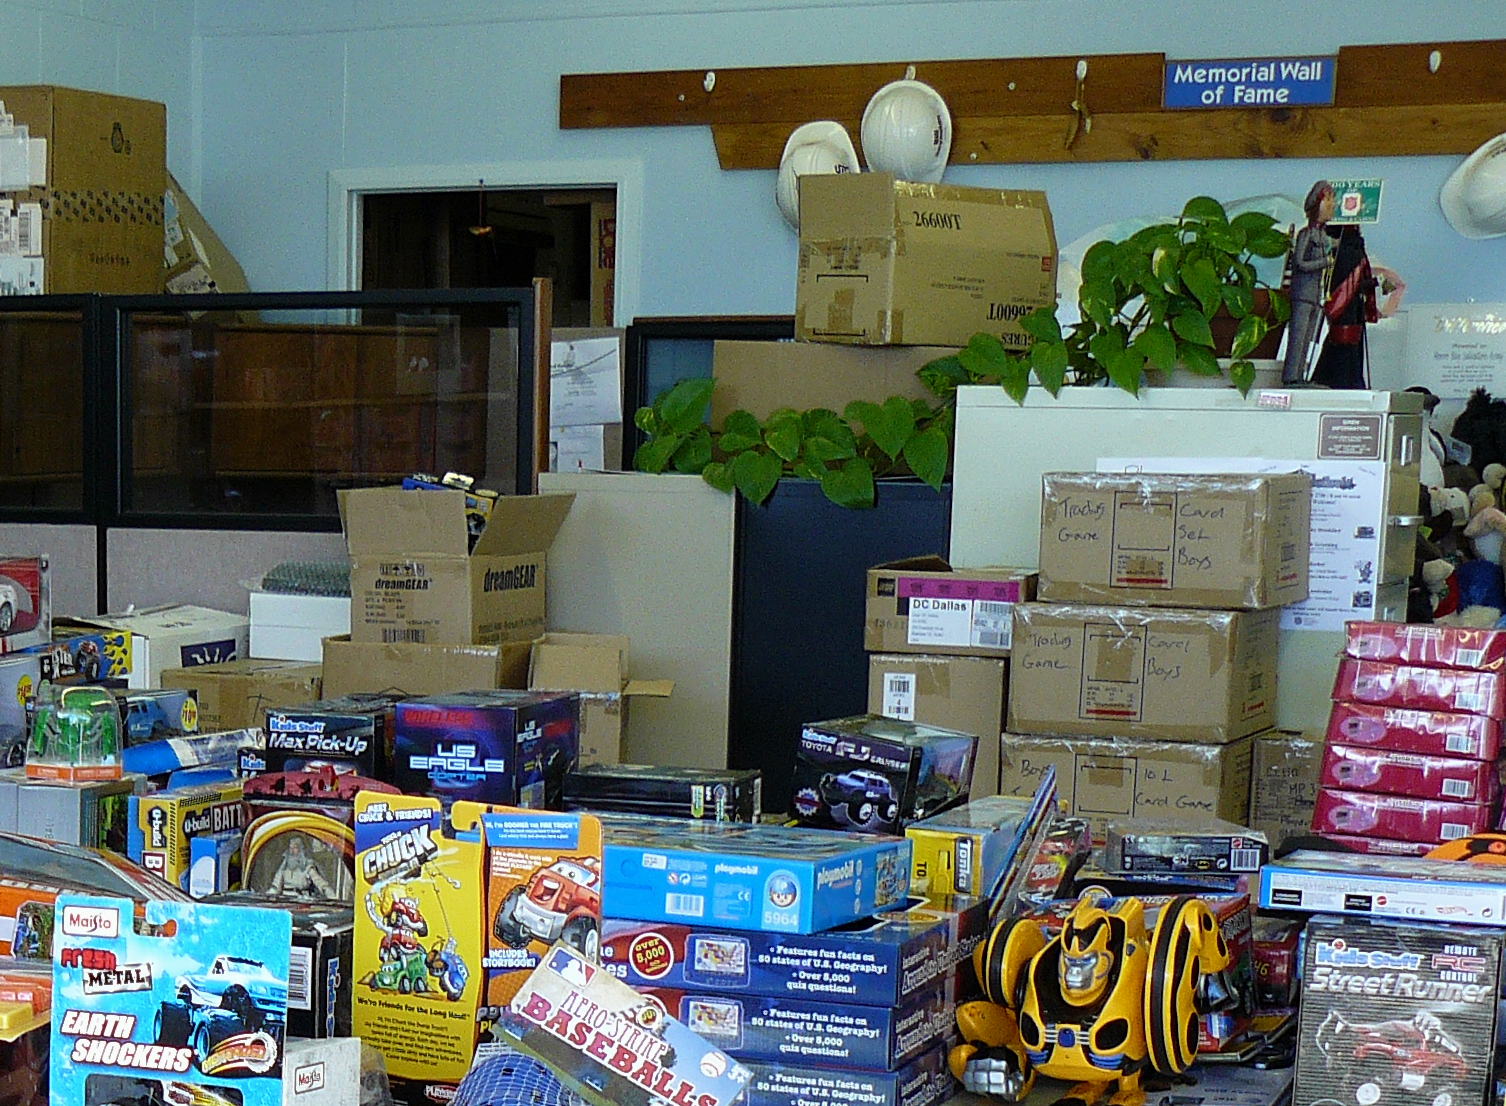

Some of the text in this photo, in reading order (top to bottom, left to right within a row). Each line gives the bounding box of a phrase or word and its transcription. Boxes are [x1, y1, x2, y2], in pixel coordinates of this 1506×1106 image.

[1174, 61, 1322, 84] Memorial Wall
[1201, 85, 1290, 105] of Fame
[913, 211, 962, 230] 26600T
[1178, 548, 1212, 570] Boys
[374, 578, 430, 590] dreamGEAR
[484, 564, 537, 592] dreamGEAR
[913, 599, 967, 611] DC Dallas
[268, 733, 367, 755] Max Pick-Up
[436, 743, 476, 757] US
[801, 740, 833, 754] TOYOTA
[409, 756, 504, 773] EAGLE
[1175, 795, 1214, 812] Game
[363, 824, 438, 879] CHUCK
[715, 863, 759, 878] playmobil
[958, 839, 972, 890] Tonka
[817, 860, 855, 890] playmobil
[69, 913, 112, 931] Maisto
[764, 910, 799, 926] 5964
[635, 938, 661, 952] over
[776, 945, 818, 957] Features
[1316, 939, 1478, 970] Kids Stuff REMOTE
[833, 961, 888, 974] Geography!
[1309, 954, 1486, 994] Street RC
[87, 969, 146, 987] METAL
[1394, 971, 1493, 1003] Runner CONTROL
[808, 983, 857, 994] questions!
[61, 1010, 137, 1039] EARTH
[826, 1024, 880, 1038] Geography!
[71, 1037, 196, 1073] SHOCKERS
[800, 1046, 849, 1057] questions!
[298, 1071, 322, 1087] Maisto
